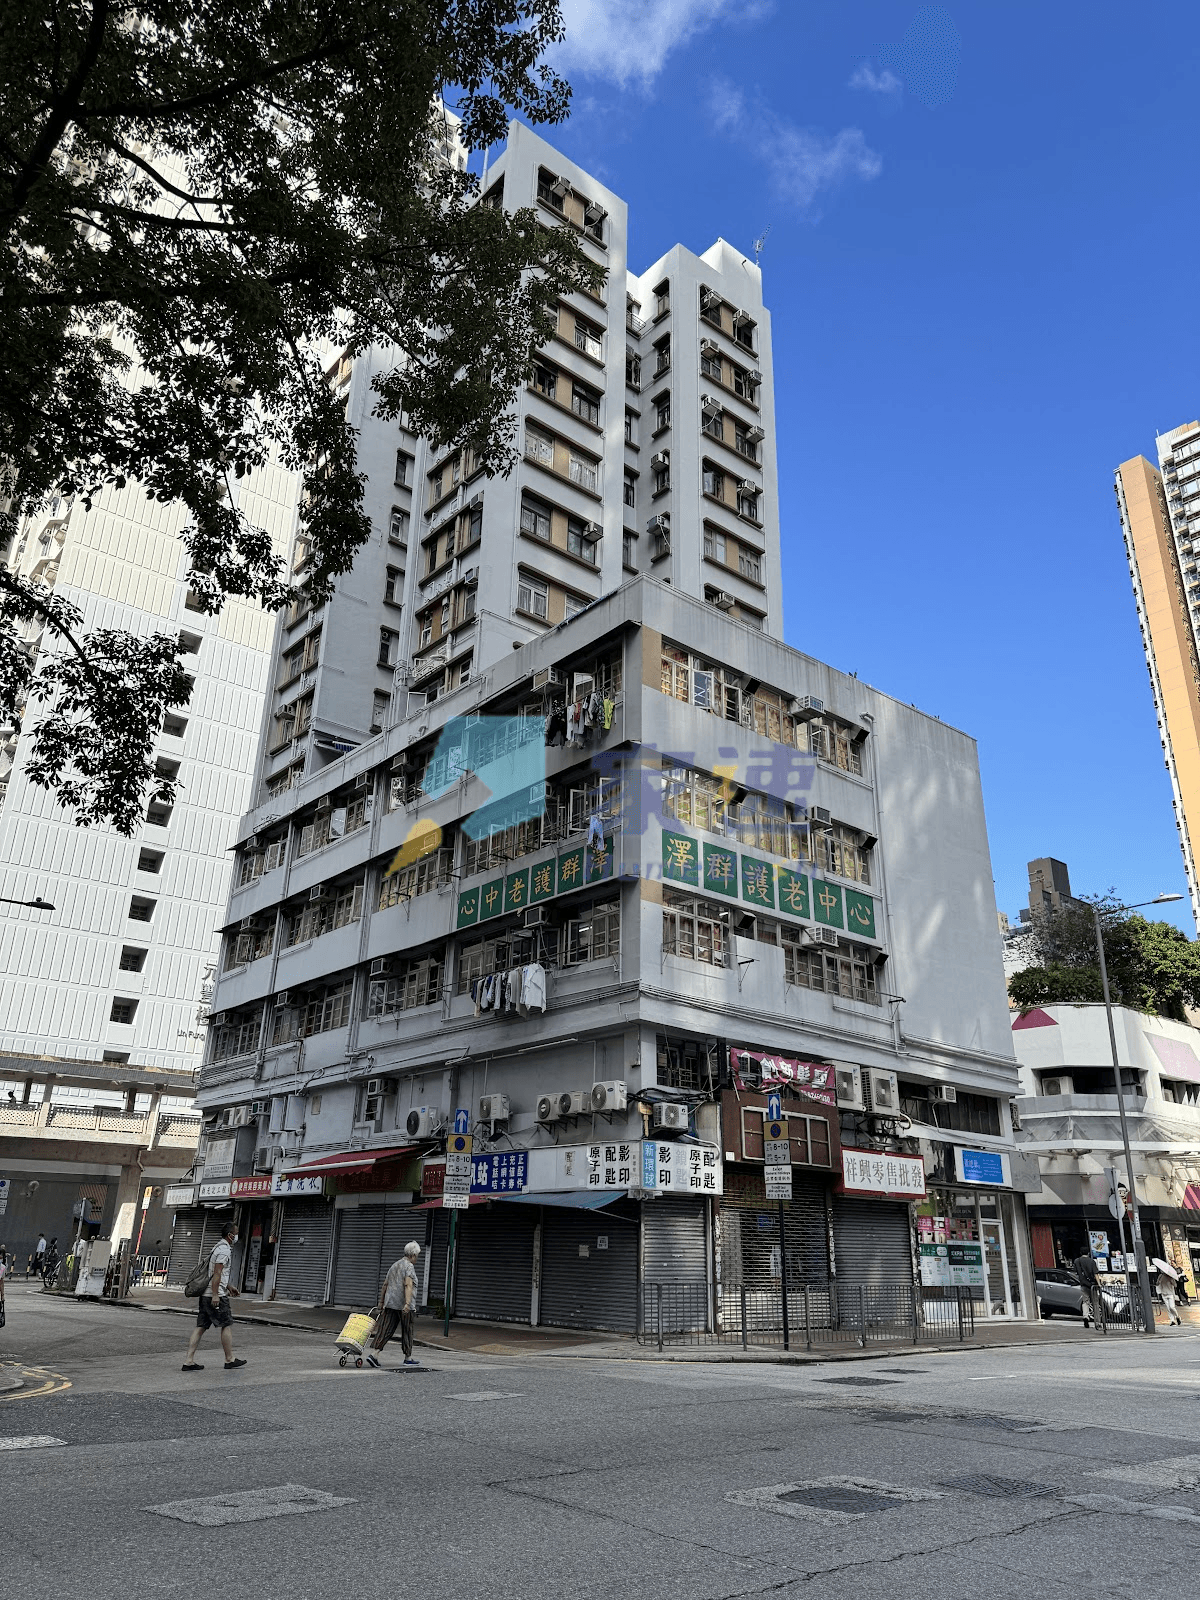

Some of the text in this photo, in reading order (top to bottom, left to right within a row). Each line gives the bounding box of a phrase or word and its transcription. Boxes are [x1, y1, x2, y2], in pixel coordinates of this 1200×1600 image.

[666, 838, 871, 926] 澤群護老中心
[456, 1155, 471, 1163] 8-10
[589, 1146, 601, 1185] 原子印
[604, 1145, 617, 1185] 配匙
[618, 1144, 630, 1185] 影印
[644, 1143, 655, 1187] 新環球
[773, 1142, 789, 1151] 8-10
[774, 1154, 787, 1162] 5-7
[455, 1165, 468, 1173] 5-7
[658, 1146, 672, 1187] 影印
[689, 1149, 702, 1189] 原子印
[703, 1151, 716, 1190] 配匙
[845, 1157, 923, 1188] 祥興零售批發
